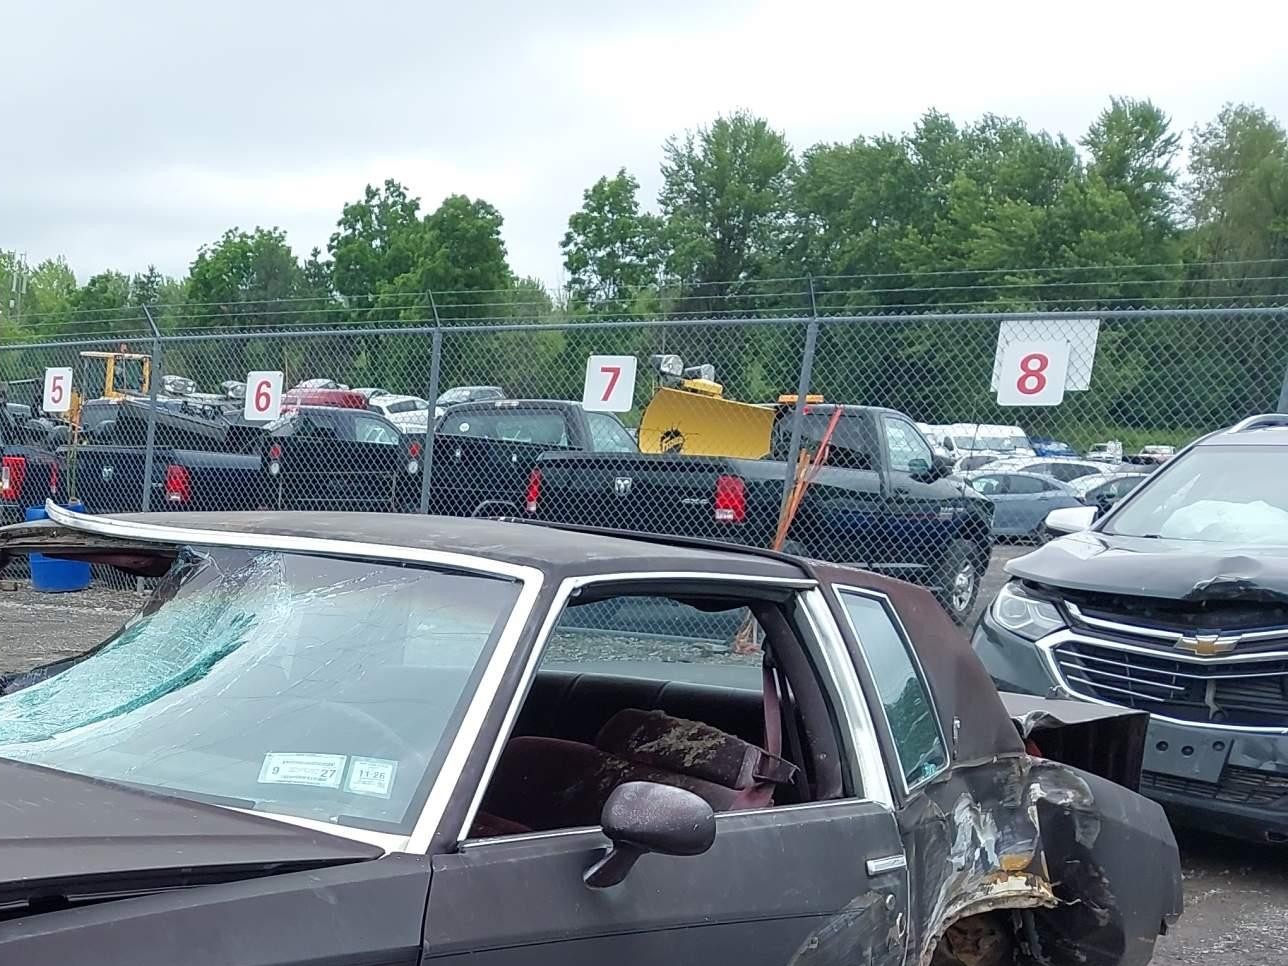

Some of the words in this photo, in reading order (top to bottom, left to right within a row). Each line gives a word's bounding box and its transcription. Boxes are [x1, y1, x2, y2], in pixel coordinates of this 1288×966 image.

[50, 375, 64, 405] 5
[599, 367, 621, 402] 7
[1016, 353, 1049, 395] 8
[254, 380, 271, 412] 6
[271, 766, 280, 775] 9
[320, 769, 336, 779] 27
